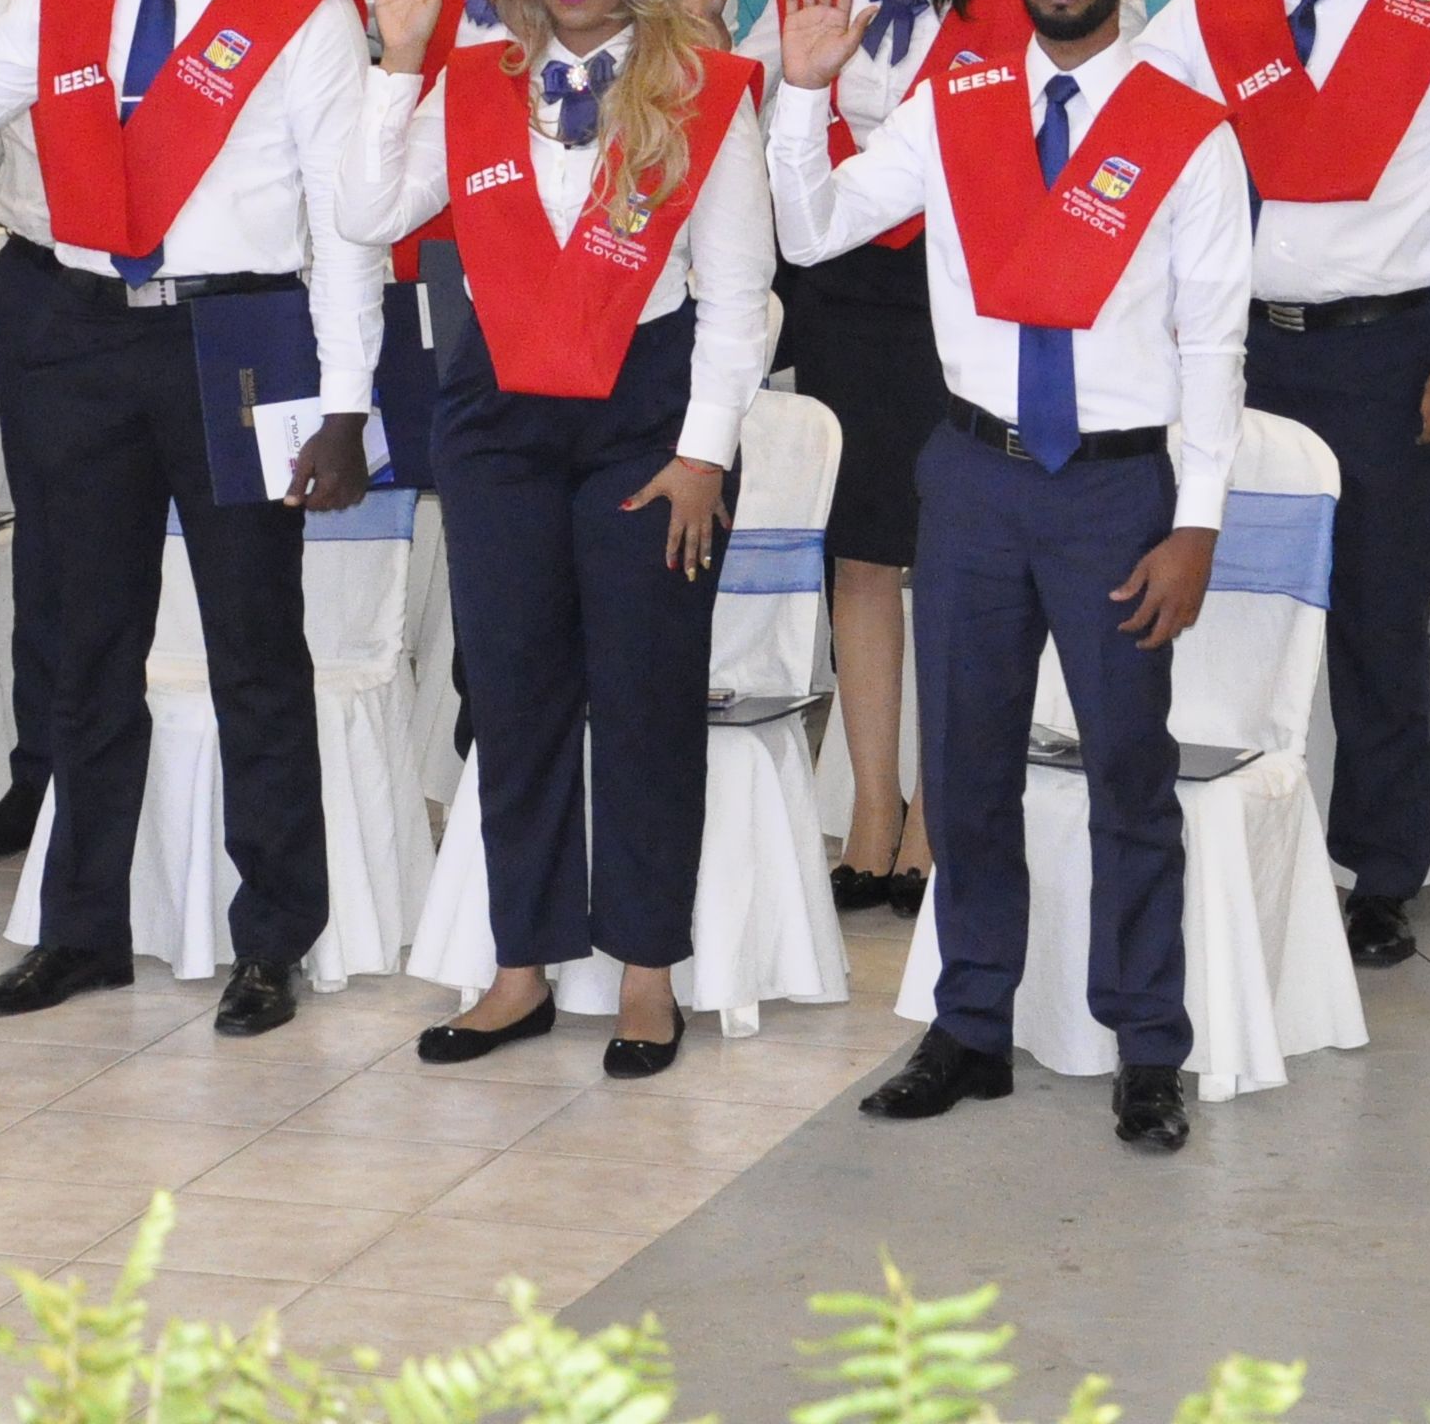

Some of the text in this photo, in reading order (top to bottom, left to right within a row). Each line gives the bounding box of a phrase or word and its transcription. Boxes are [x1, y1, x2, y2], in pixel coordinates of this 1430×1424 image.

[54, 64, 105, 95] IEESL
[176, 68, 224, 106] LOYOLA
[948, 67, 1016, 95] IEESL
[1236, 58, 1292, 101] IEESL
[466, 160, 523, 196] IEESL
[1062, 202, 1116, 238] LOYOLA
[584, 242, 639, 271] LOYOLA
[290, 415, 301, 454] OYOLA
